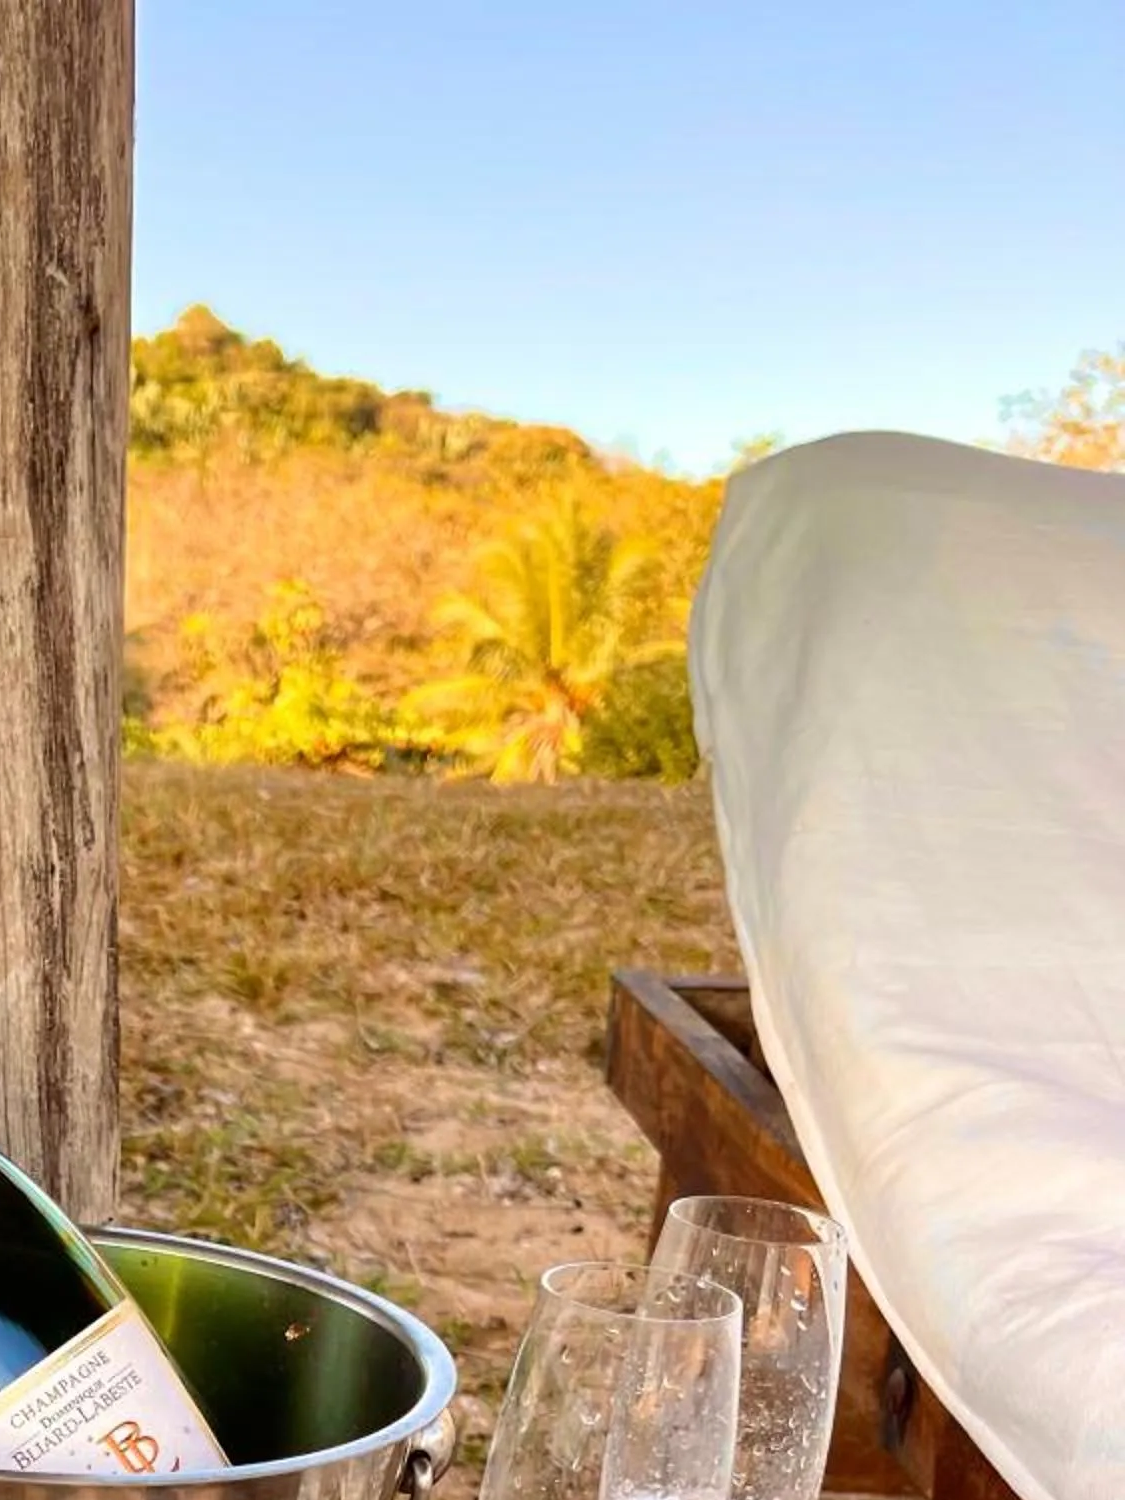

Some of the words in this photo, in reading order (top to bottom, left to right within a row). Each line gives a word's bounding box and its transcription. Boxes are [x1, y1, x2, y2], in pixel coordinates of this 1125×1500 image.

[9, 1349, 112, 1430] CHAMPAGNE
[10, 1369, 143, 1472] BLIARD-LABESTE
[40, 1379, 105, 1431] DOMINIQUE
